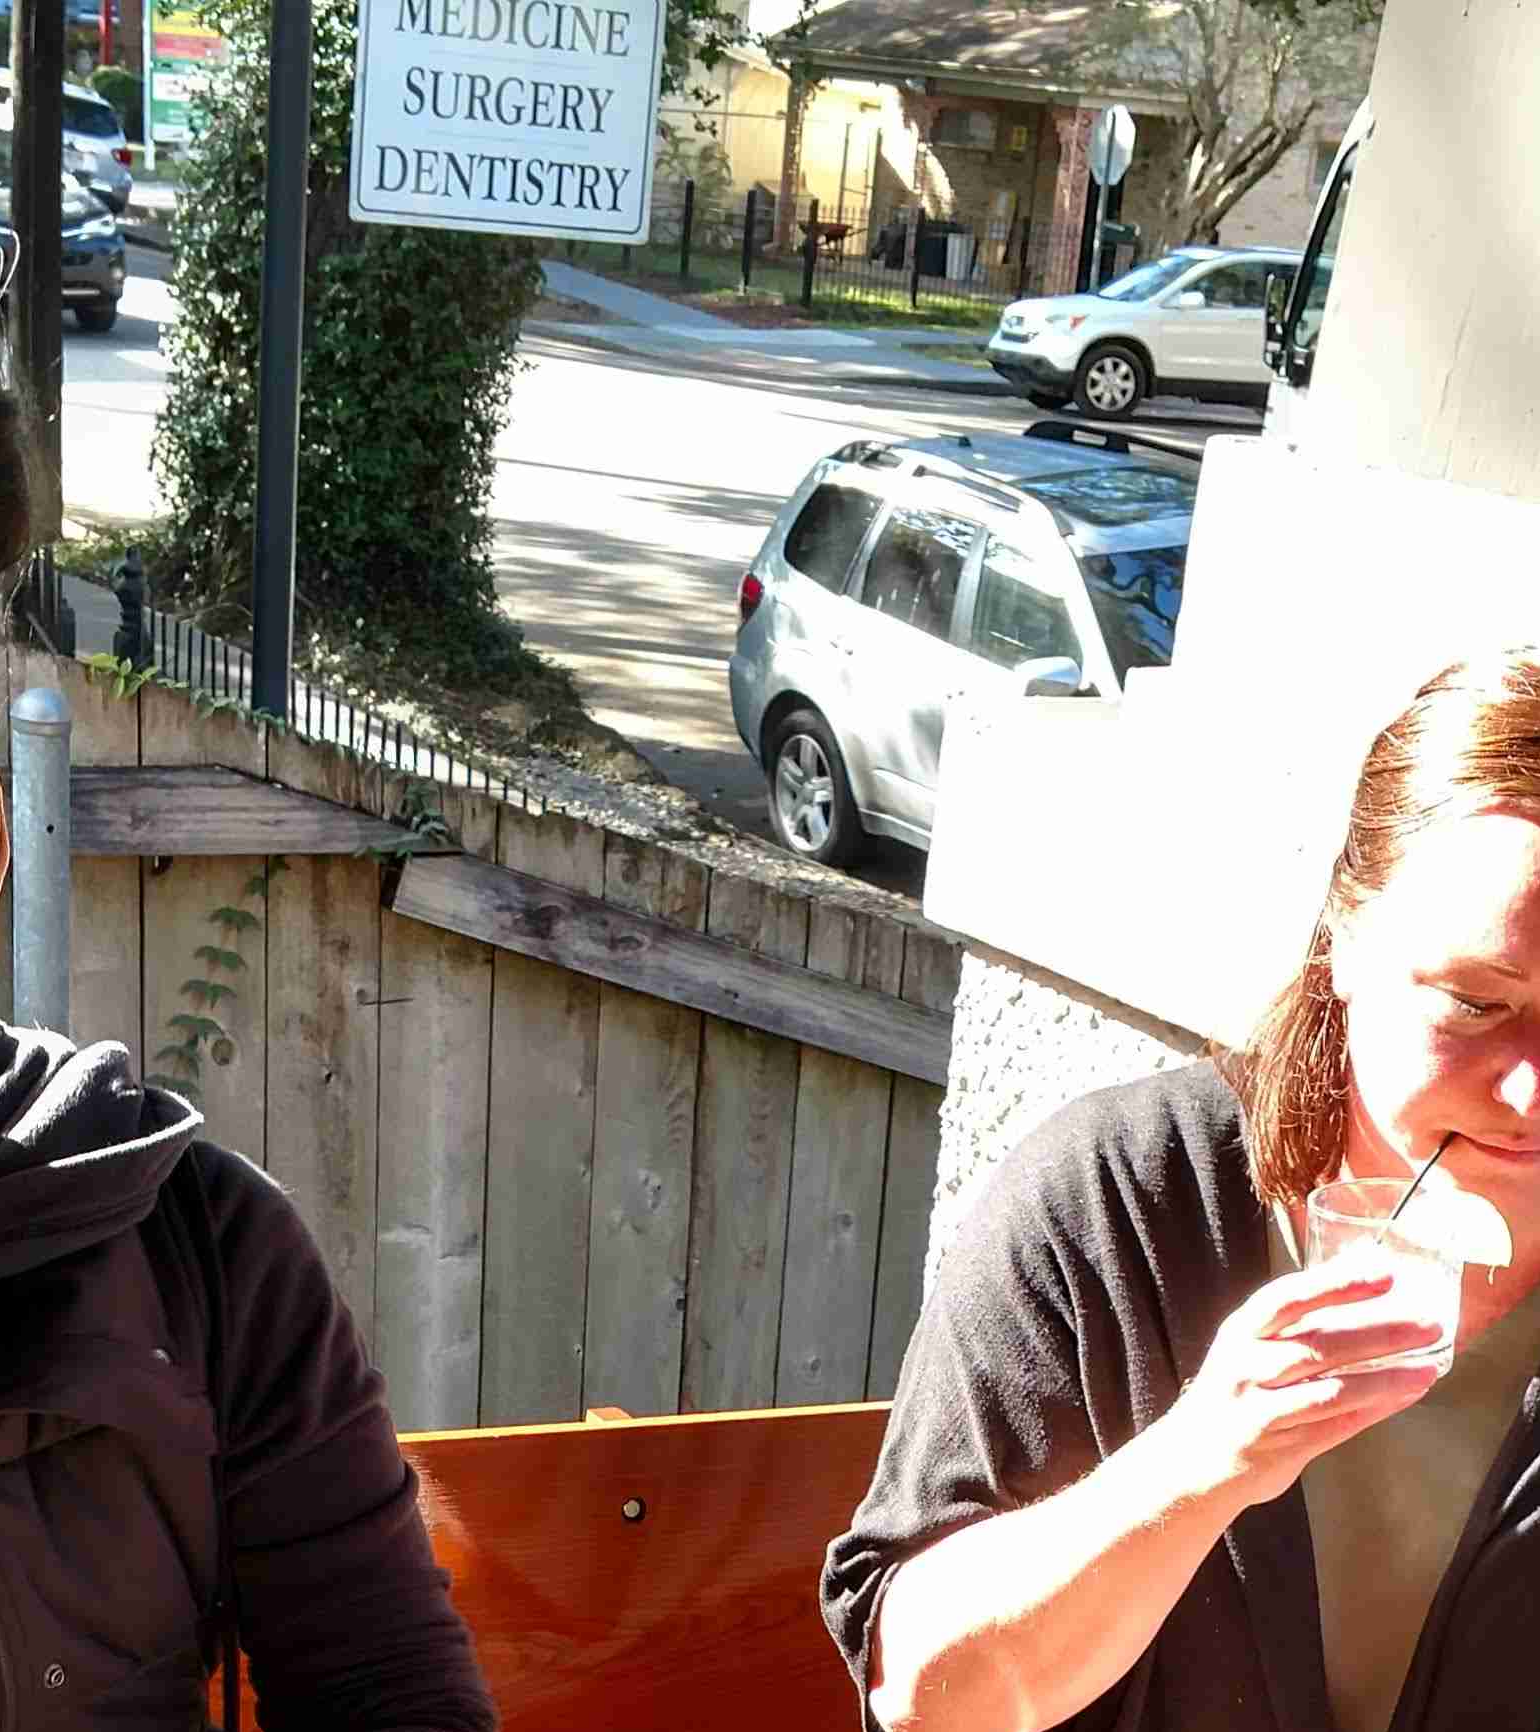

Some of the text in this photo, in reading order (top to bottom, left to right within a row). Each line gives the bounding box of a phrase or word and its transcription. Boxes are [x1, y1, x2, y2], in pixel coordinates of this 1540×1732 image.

[395, 0, 630, 57] MEDICINE
[403, 66, 613, 133] SURGERY
[374, 145, 631, 212] DENTISTRY
